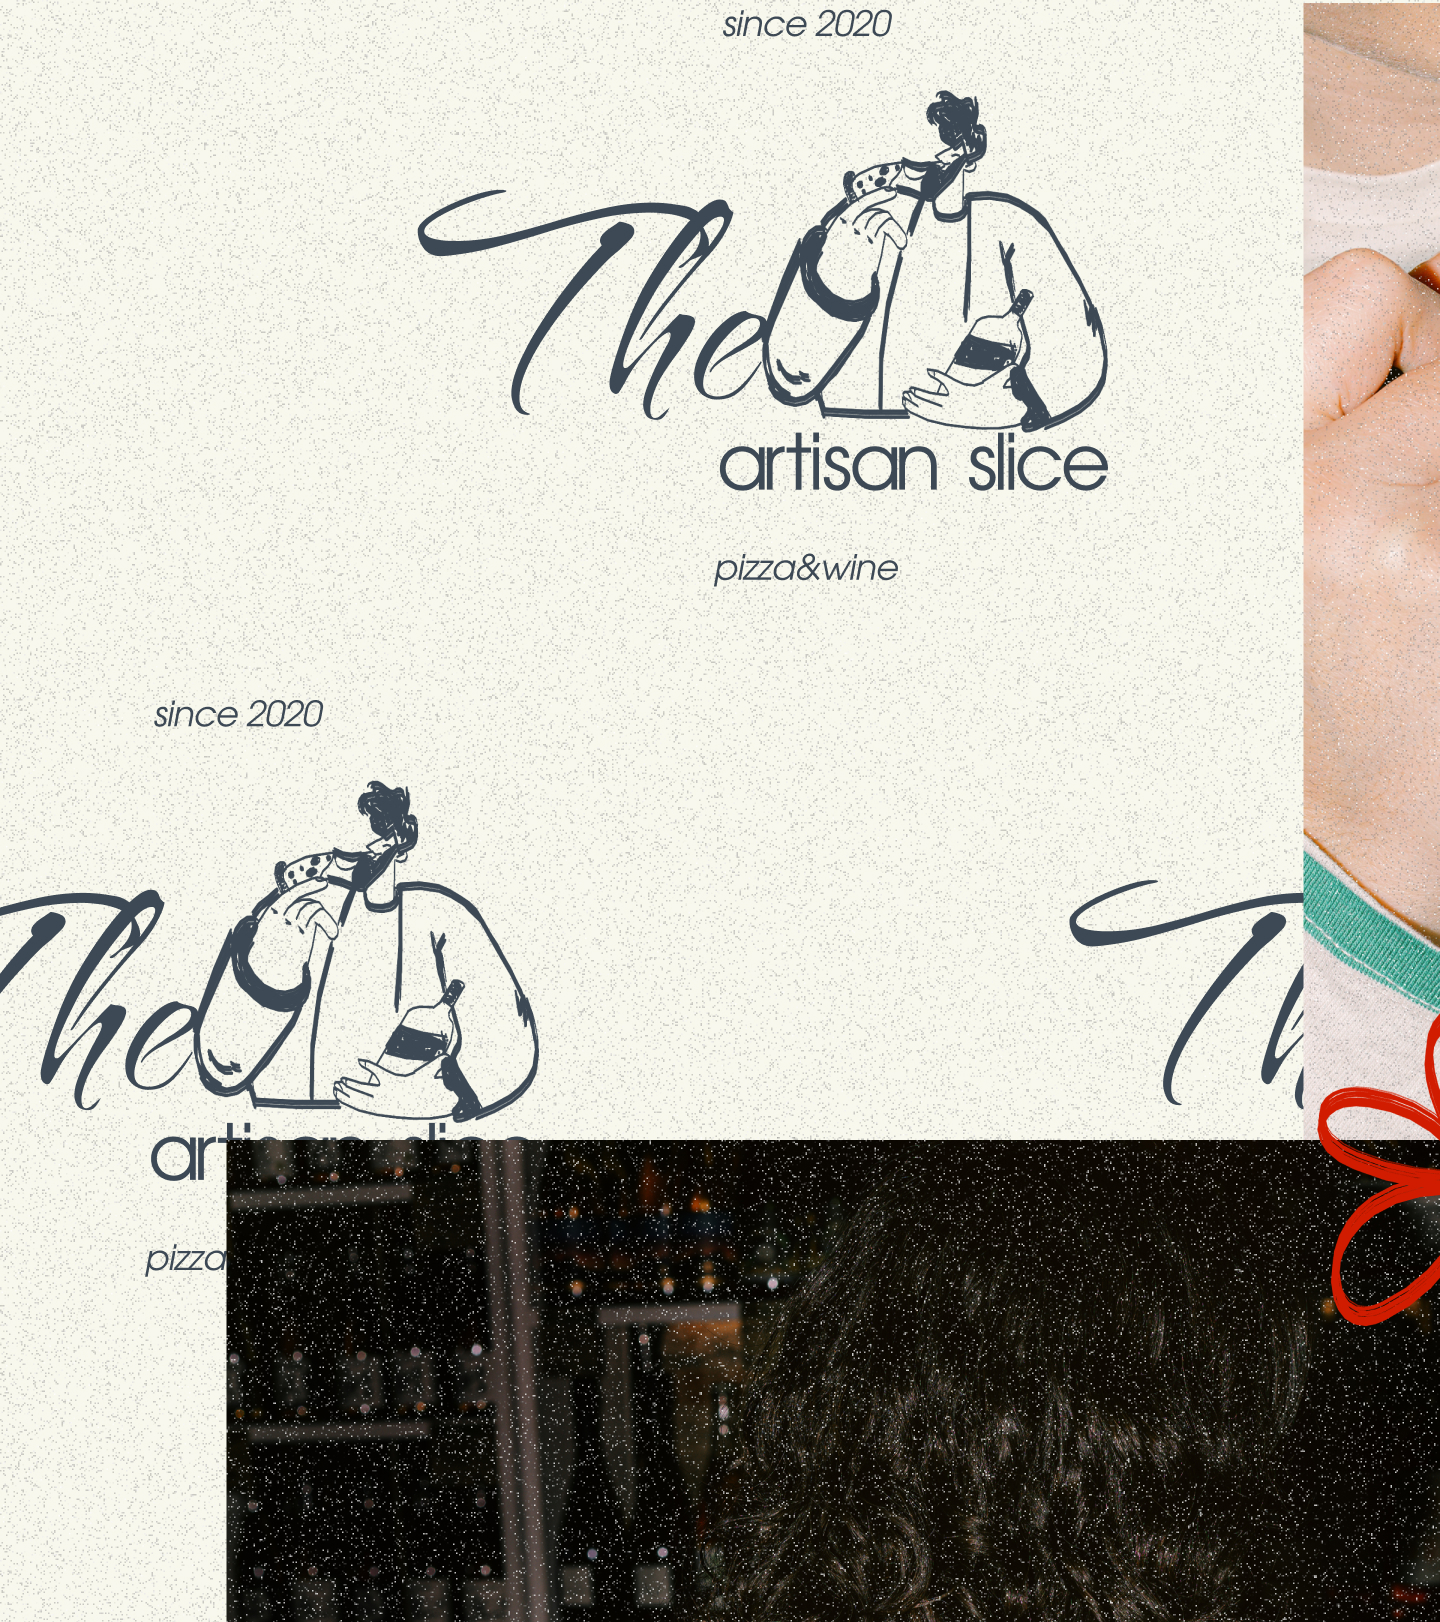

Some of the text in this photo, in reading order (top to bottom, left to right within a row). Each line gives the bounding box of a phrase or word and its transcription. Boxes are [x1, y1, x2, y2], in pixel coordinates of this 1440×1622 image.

[723, 9, 893, 37] since 2020
[418, 190, 764, 420] The
[720, 433, 1108, 491] artisan slice
[714, 553, 899, 587] pizza&wine
[154, 700, 324, 728] since 2020
